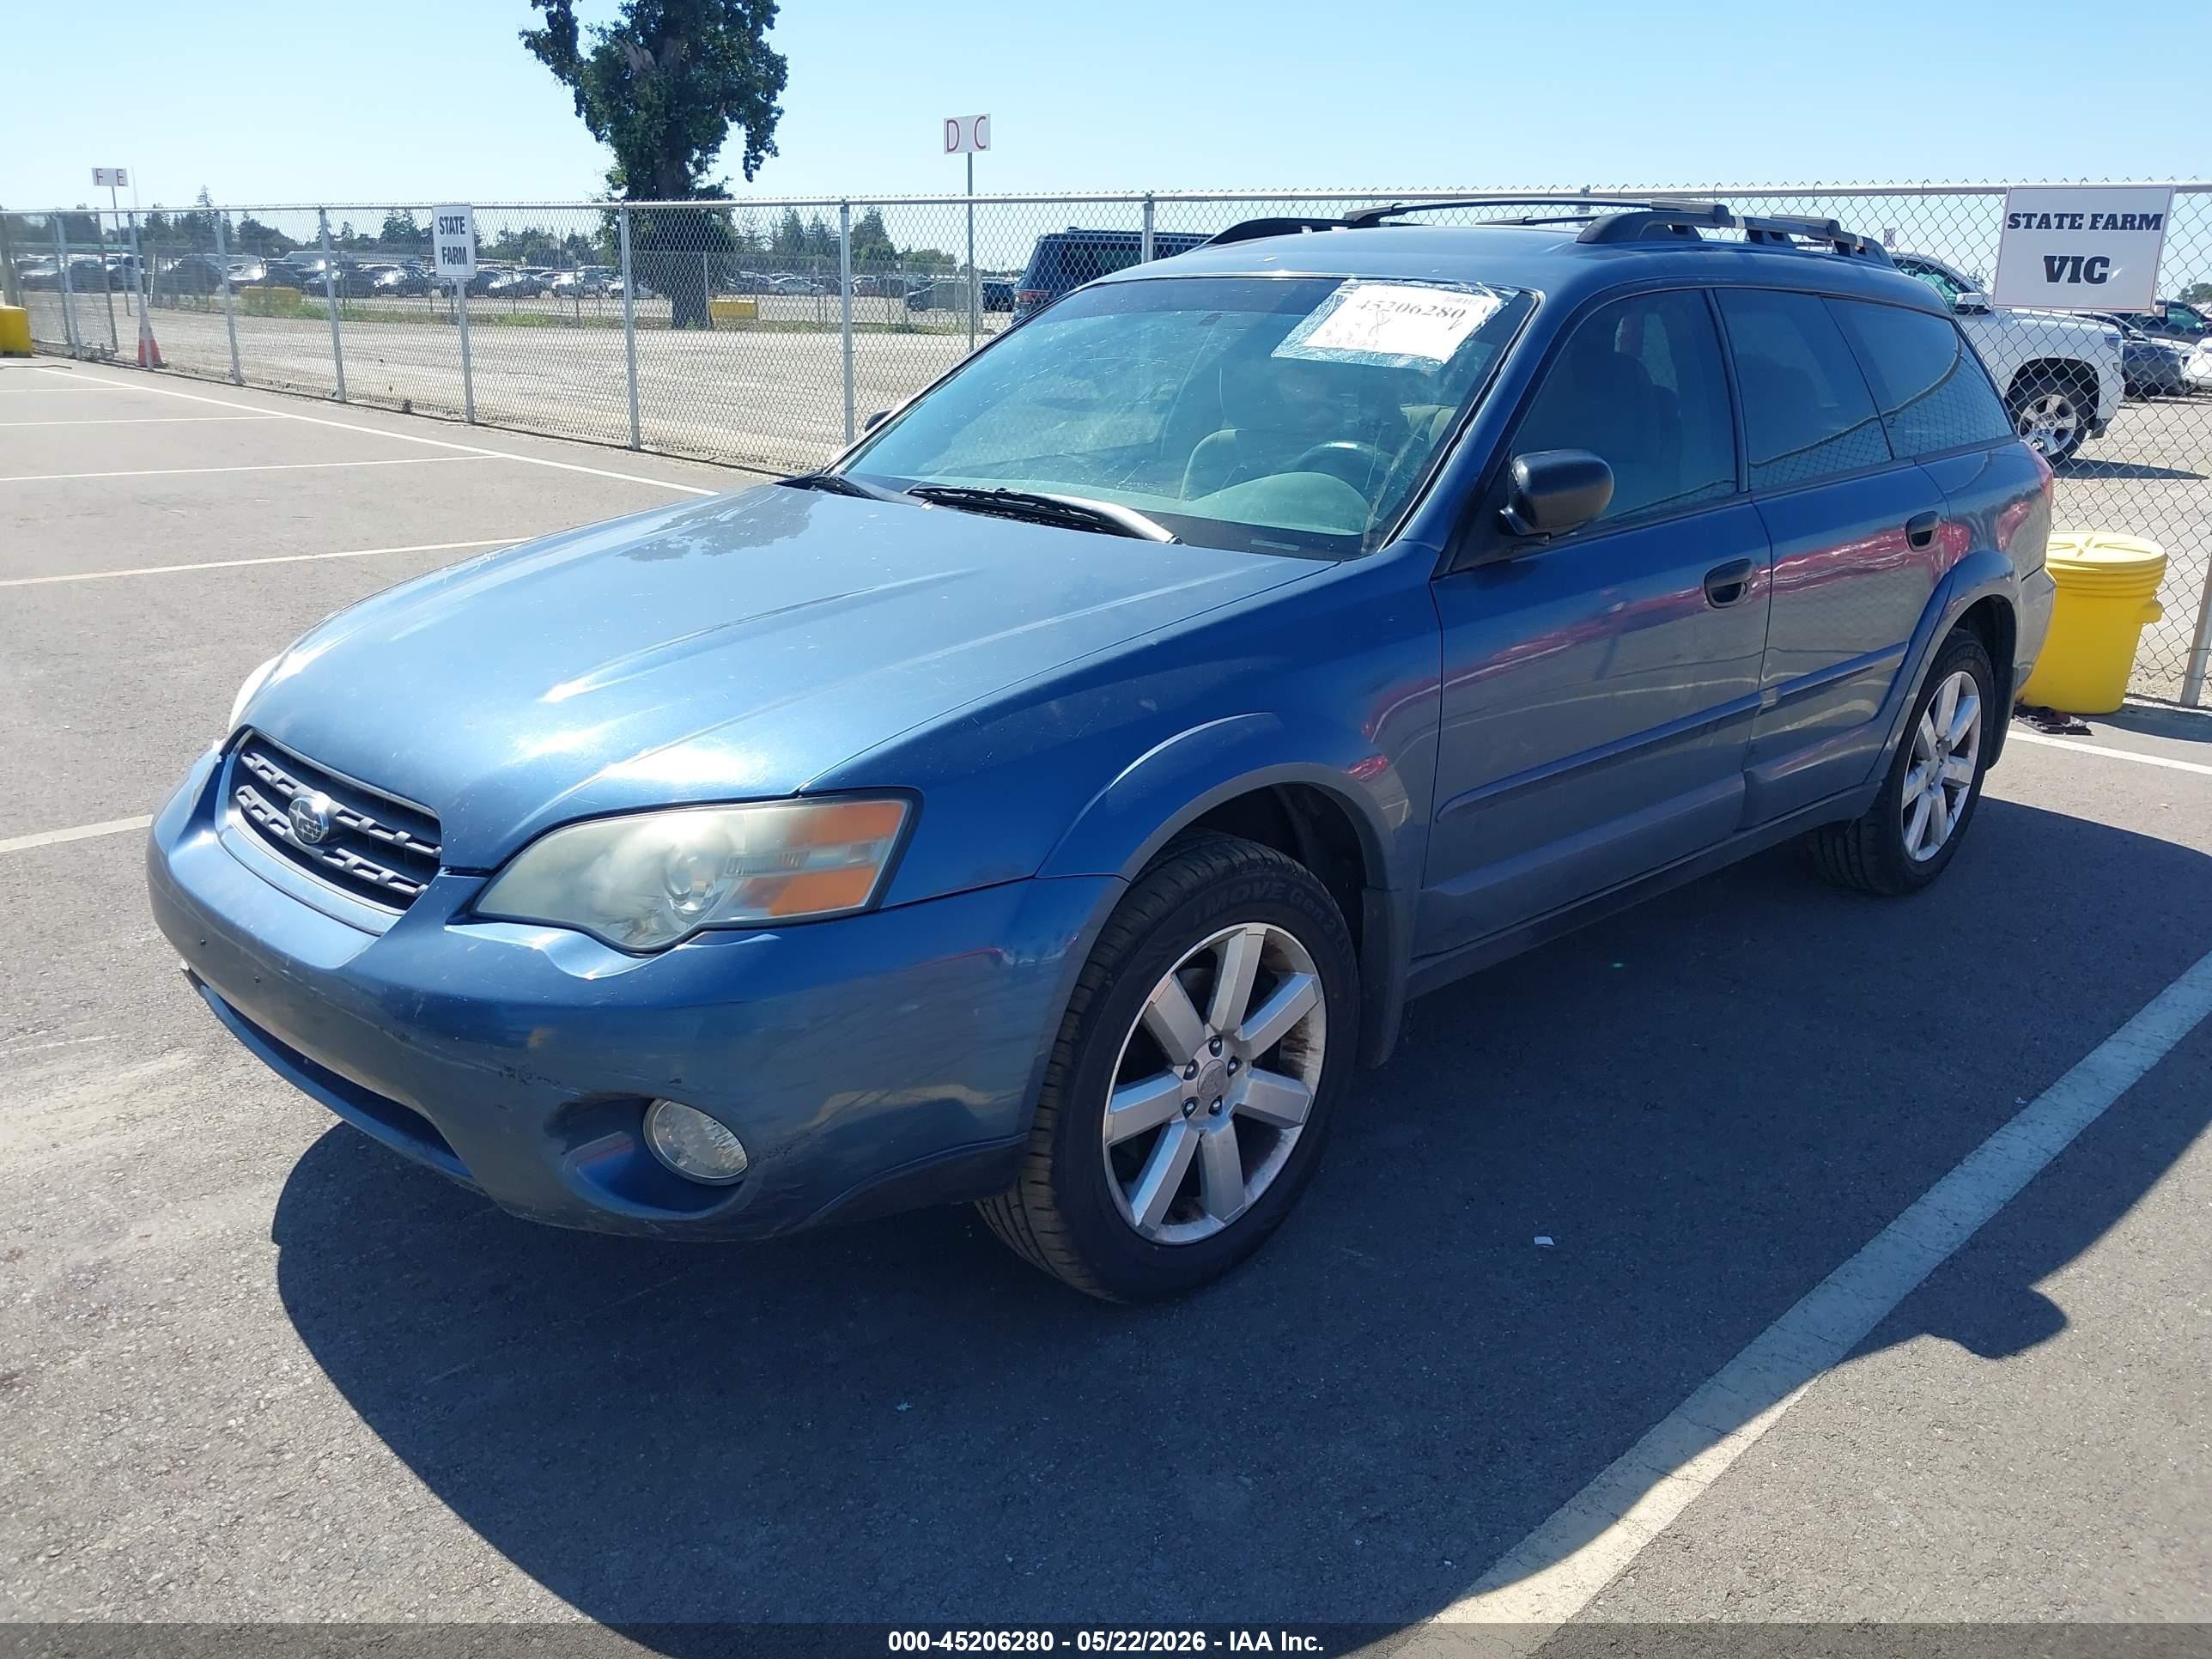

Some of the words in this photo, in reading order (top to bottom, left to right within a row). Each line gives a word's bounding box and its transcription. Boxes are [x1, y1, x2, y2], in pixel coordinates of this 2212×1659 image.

[947, 119, 960, 152] D
[974, 116, 987, 150] C
[95, 168, 104, 186] F
[116, 168, 125, 186] E
[439, 216, 466, 235] STATE
[2007, 212, 2083, 231] STATE
[2087, 213, 2164, 231] FARM
[441, 246, 468, 265] FARM
[2043, 255, 2111, 285] VIC
[1356, 300, 1467, 319] 45206280
